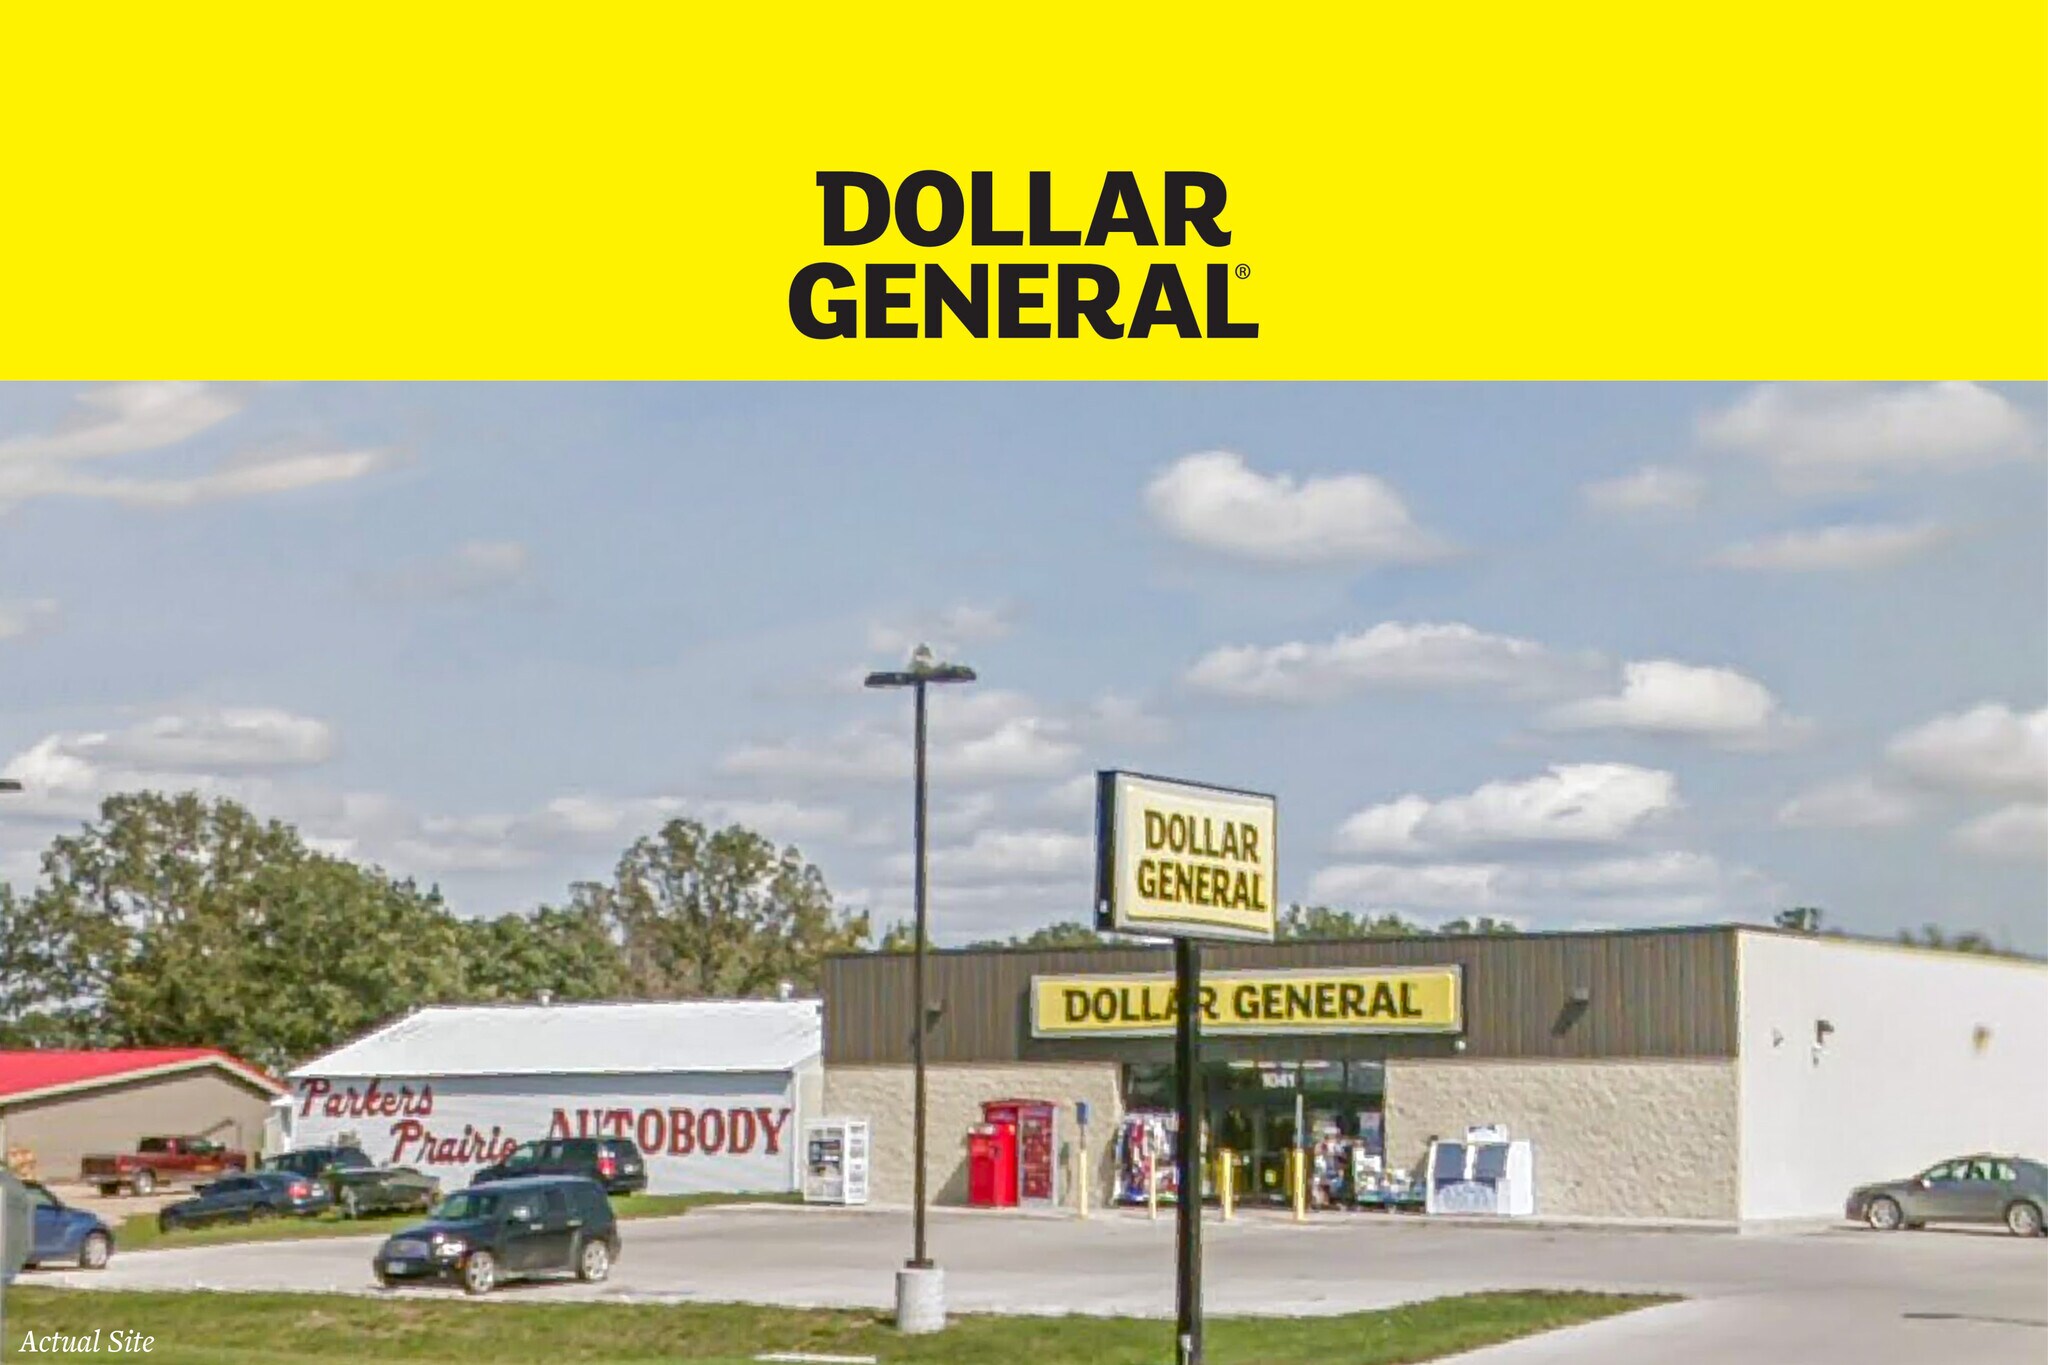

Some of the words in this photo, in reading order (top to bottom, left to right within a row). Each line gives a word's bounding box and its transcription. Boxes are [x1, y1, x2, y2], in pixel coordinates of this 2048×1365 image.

[1144, 810, 1260, 864] DOLLAR
[1138, 859, 1267, 911] GENERAL
[1232, 981, 1421, 1019] GENERAL
[300, 1078, 433, 1117] Parkers
[1262, 1072, 1296, 1089] 1041
[390, 1118, 518, 1165] Prairie
[550, 1107, 792, 1156] AUTOBODY
